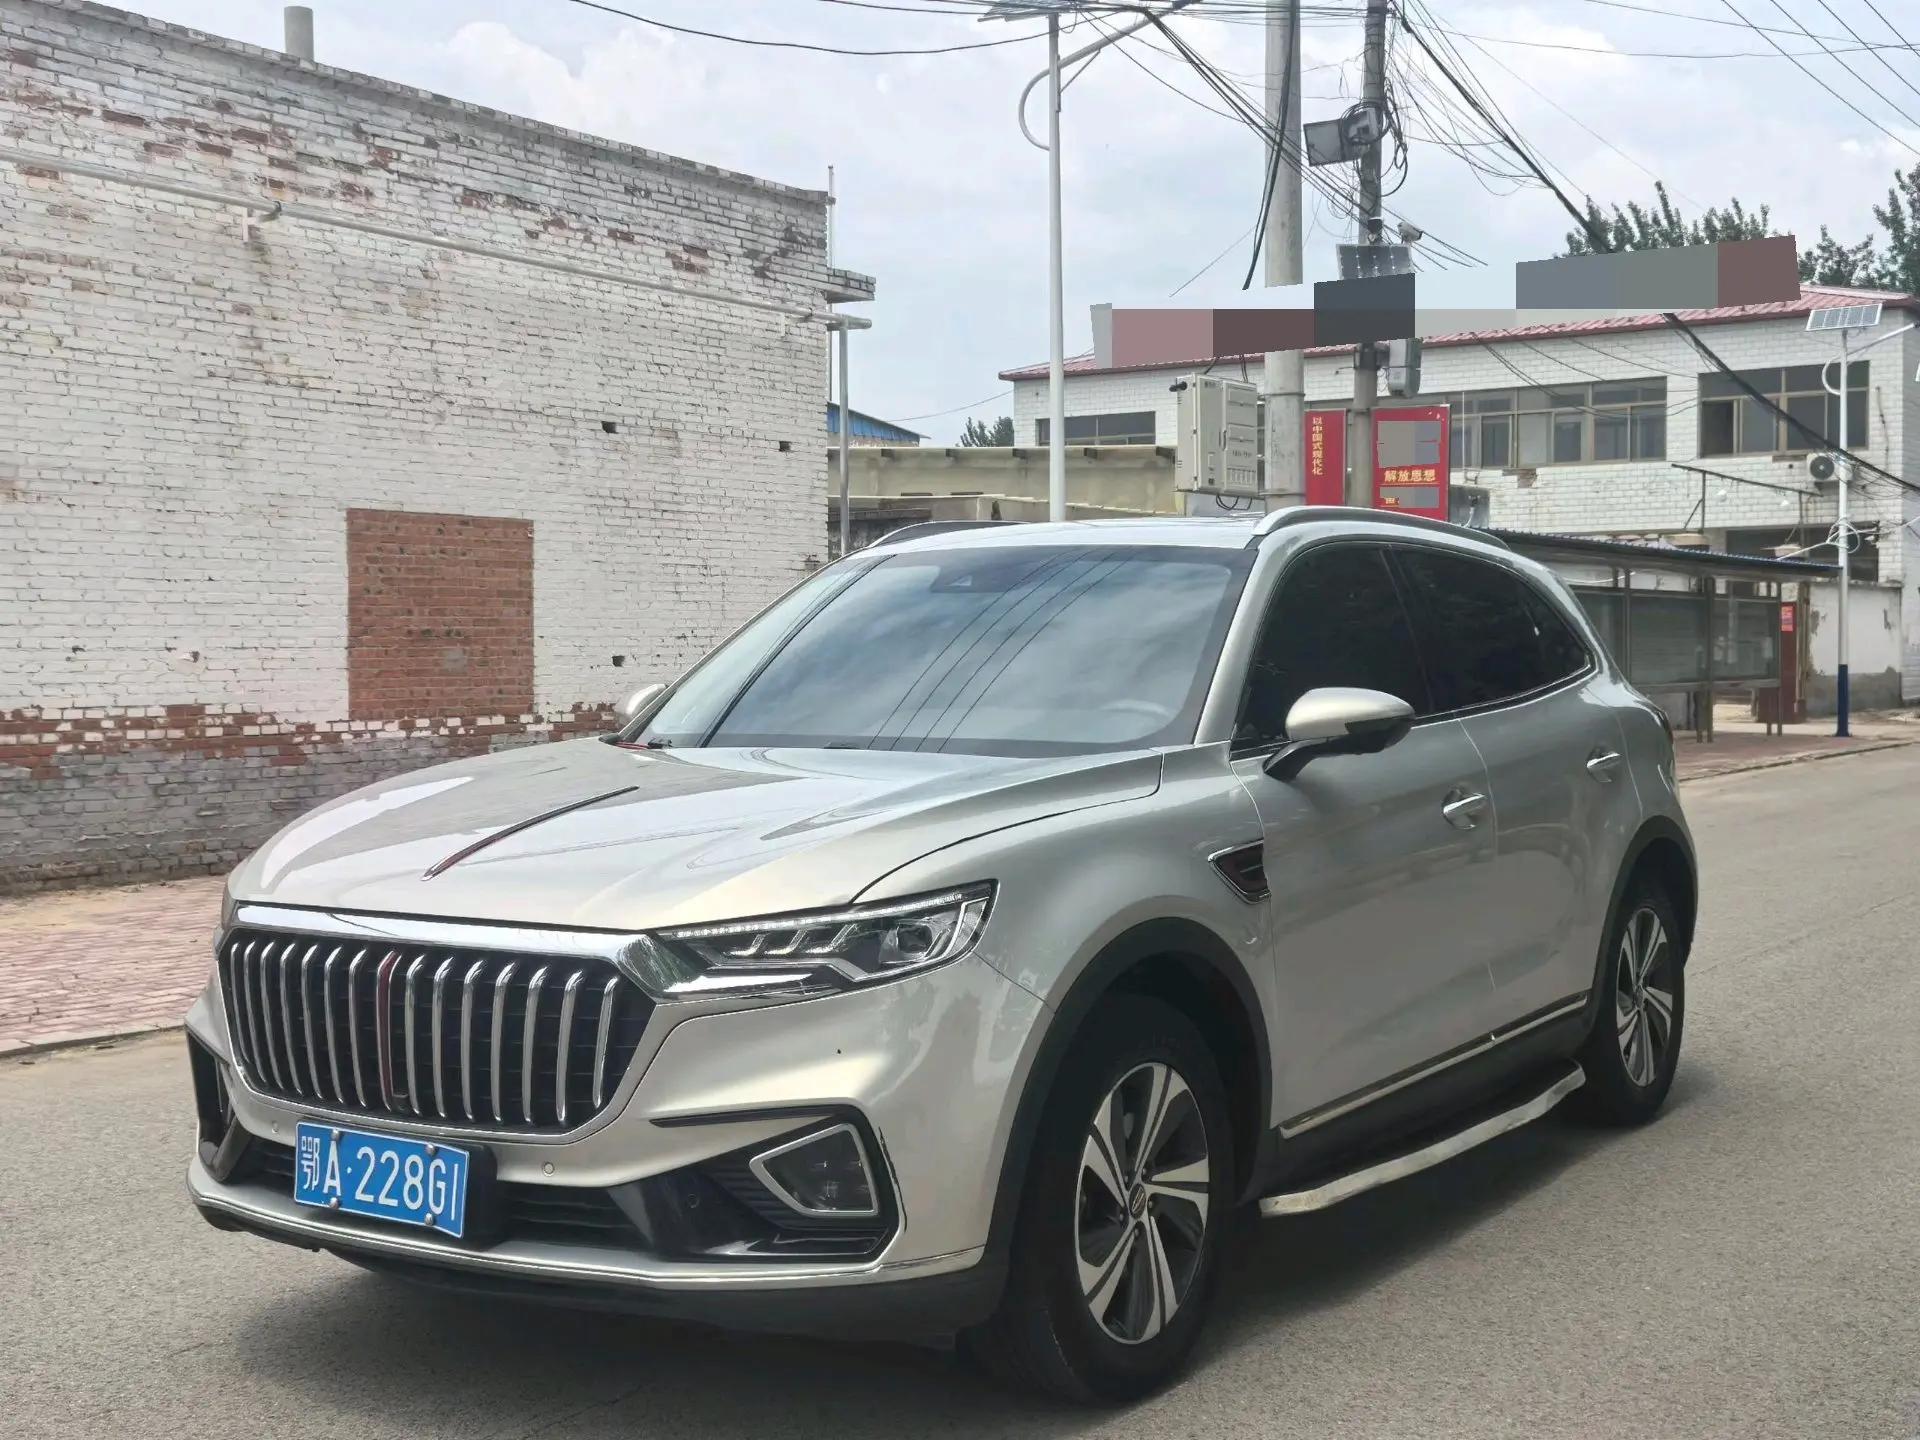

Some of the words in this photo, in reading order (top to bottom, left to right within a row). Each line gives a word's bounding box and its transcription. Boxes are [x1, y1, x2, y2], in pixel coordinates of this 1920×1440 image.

[1311, 416, 1324, 476] 以中国式现代化
[1384, 469, 1436, 482] 解放思想
